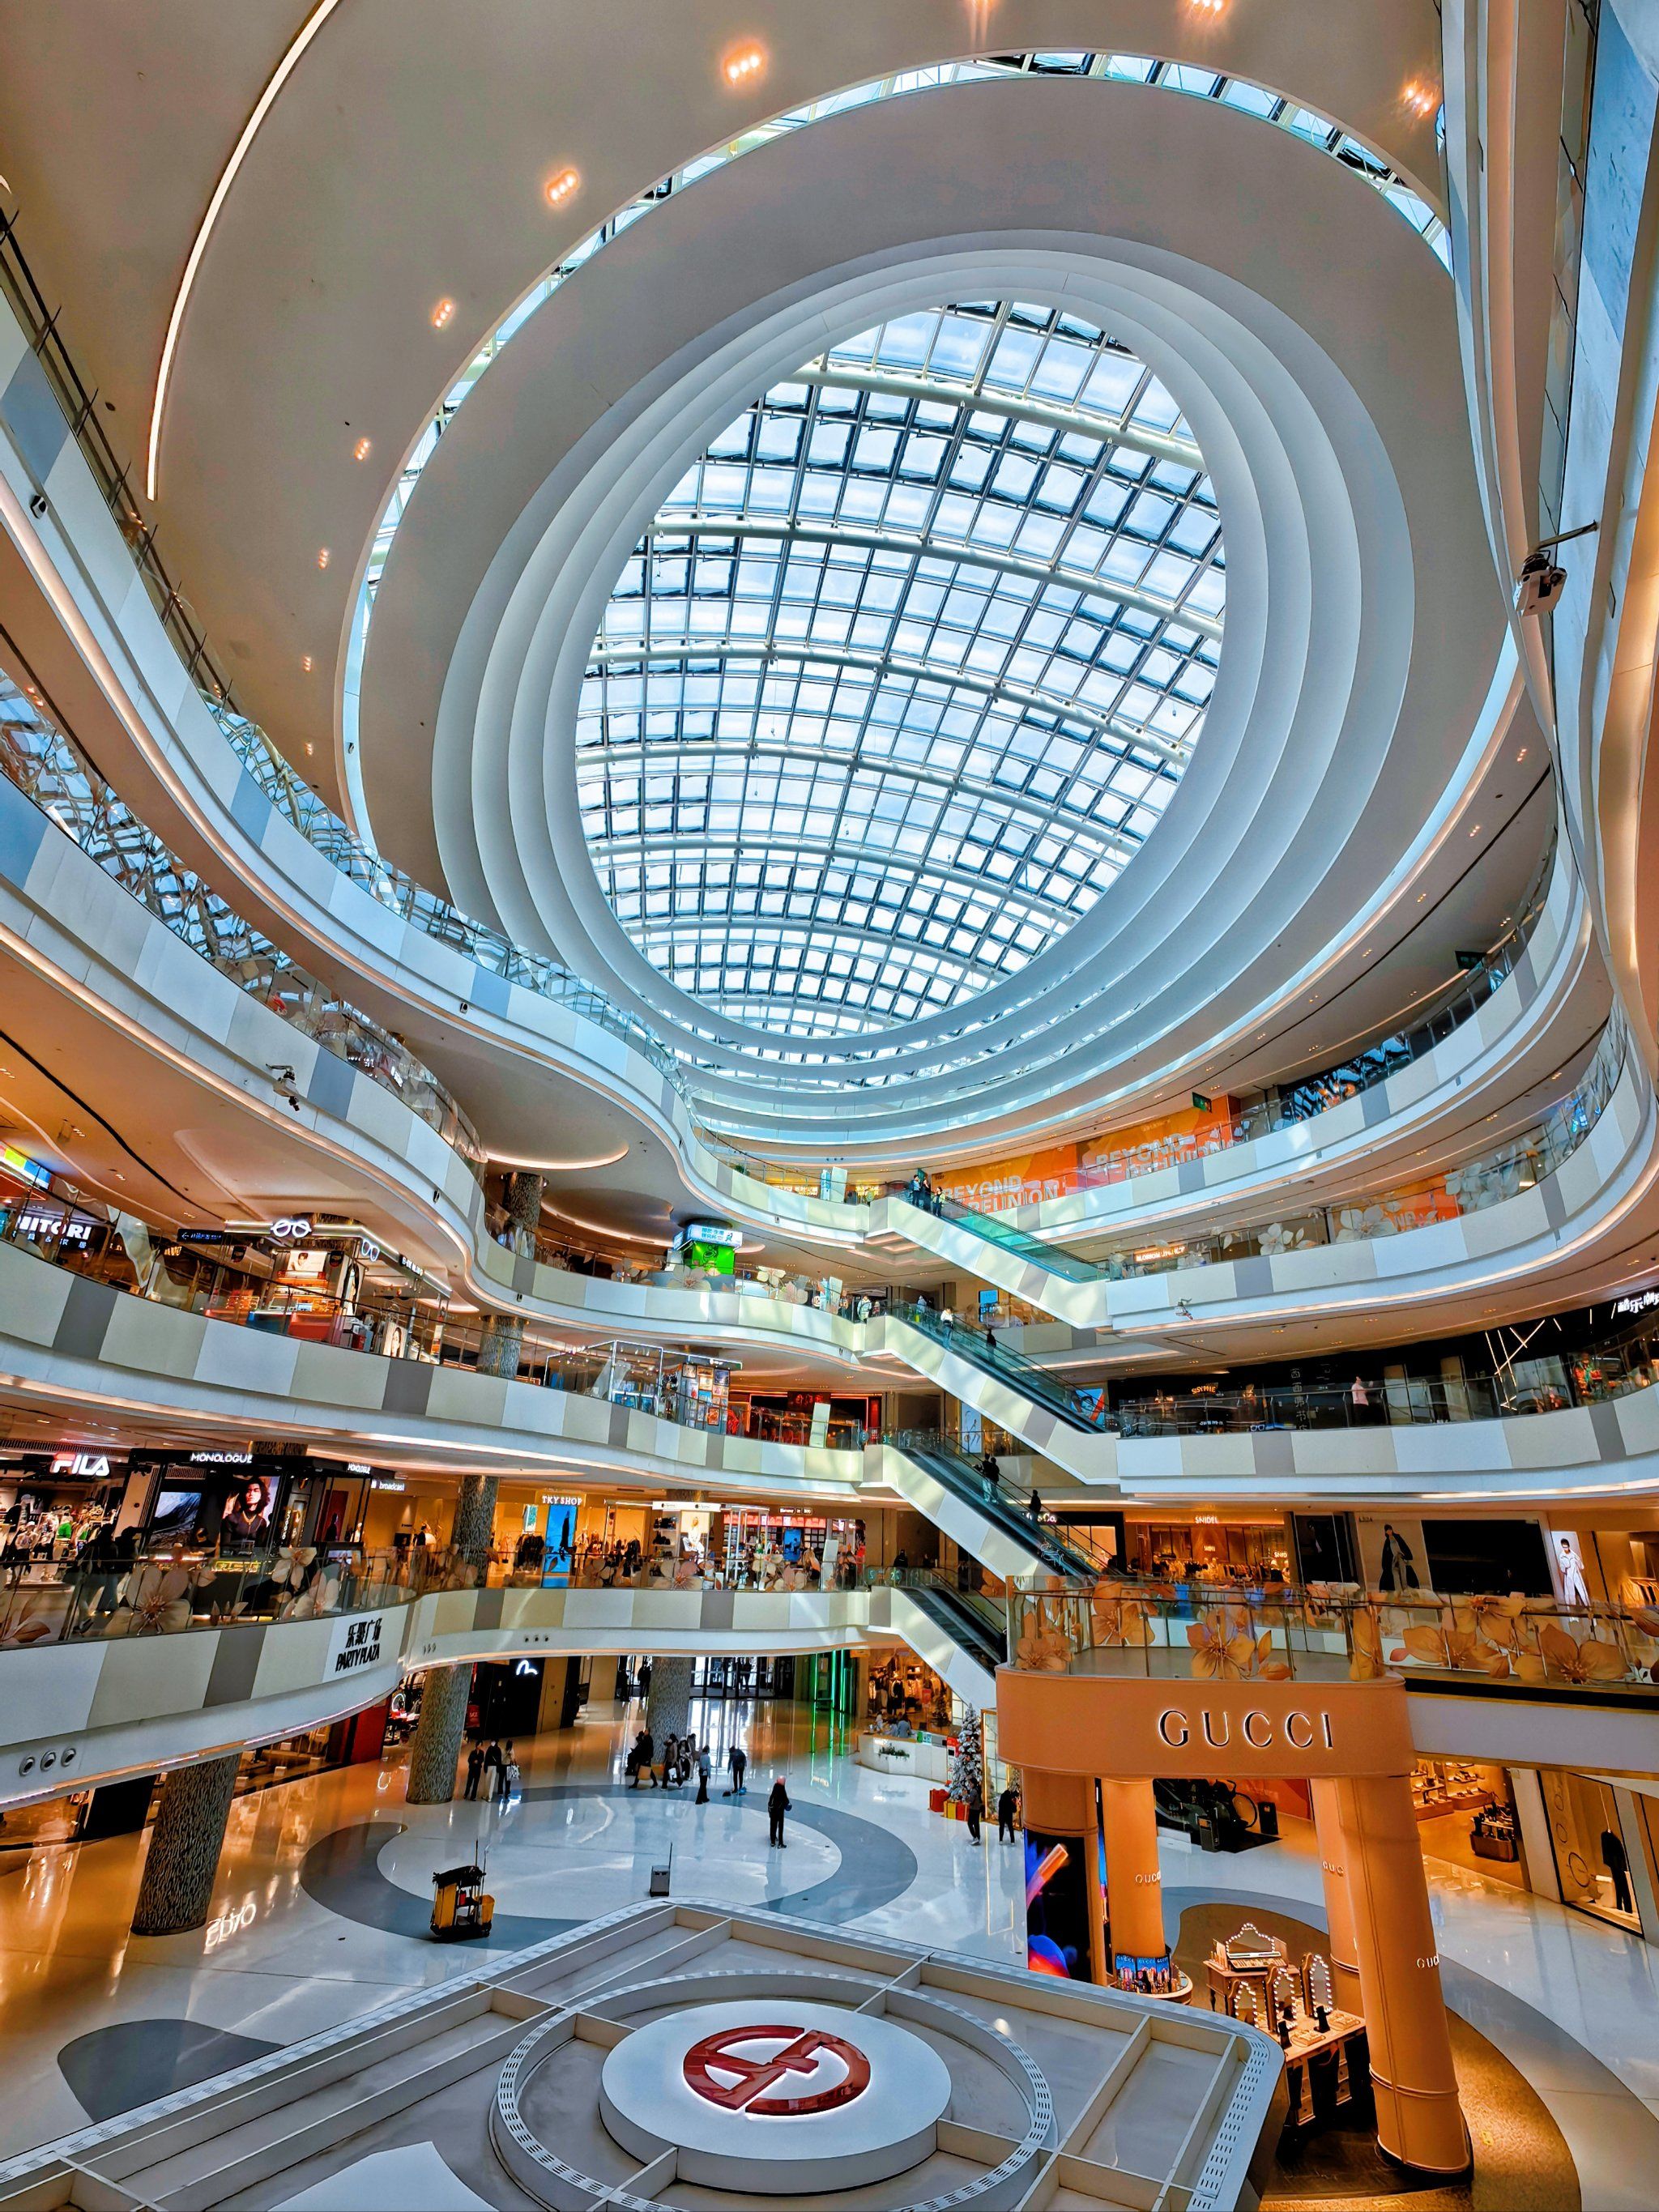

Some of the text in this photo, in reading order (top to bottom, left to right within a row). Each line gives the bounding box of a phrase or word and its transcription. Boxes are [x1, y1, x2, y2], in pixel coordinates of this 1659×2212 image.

[1096, 1133, 1186, 1165] BEYOND
[943, 1175, 1022, 1199] BEYOND
[967, 1184, 1058, 1213] REUNION
[50, 1452, 110, 1476] FILA
[190, 1452, 253, 1464] MONOLOGUE
[379, 1479, 405, 1491] broadcast
[542, 1495, 582, 1506] TKY SHOP
[1195, 1516, 1218, 1524] SNIDEL
[335, 1643, 380, 1673] PARTY PLAZA
[1158, 1709, 1333, 1749] GUCCI
